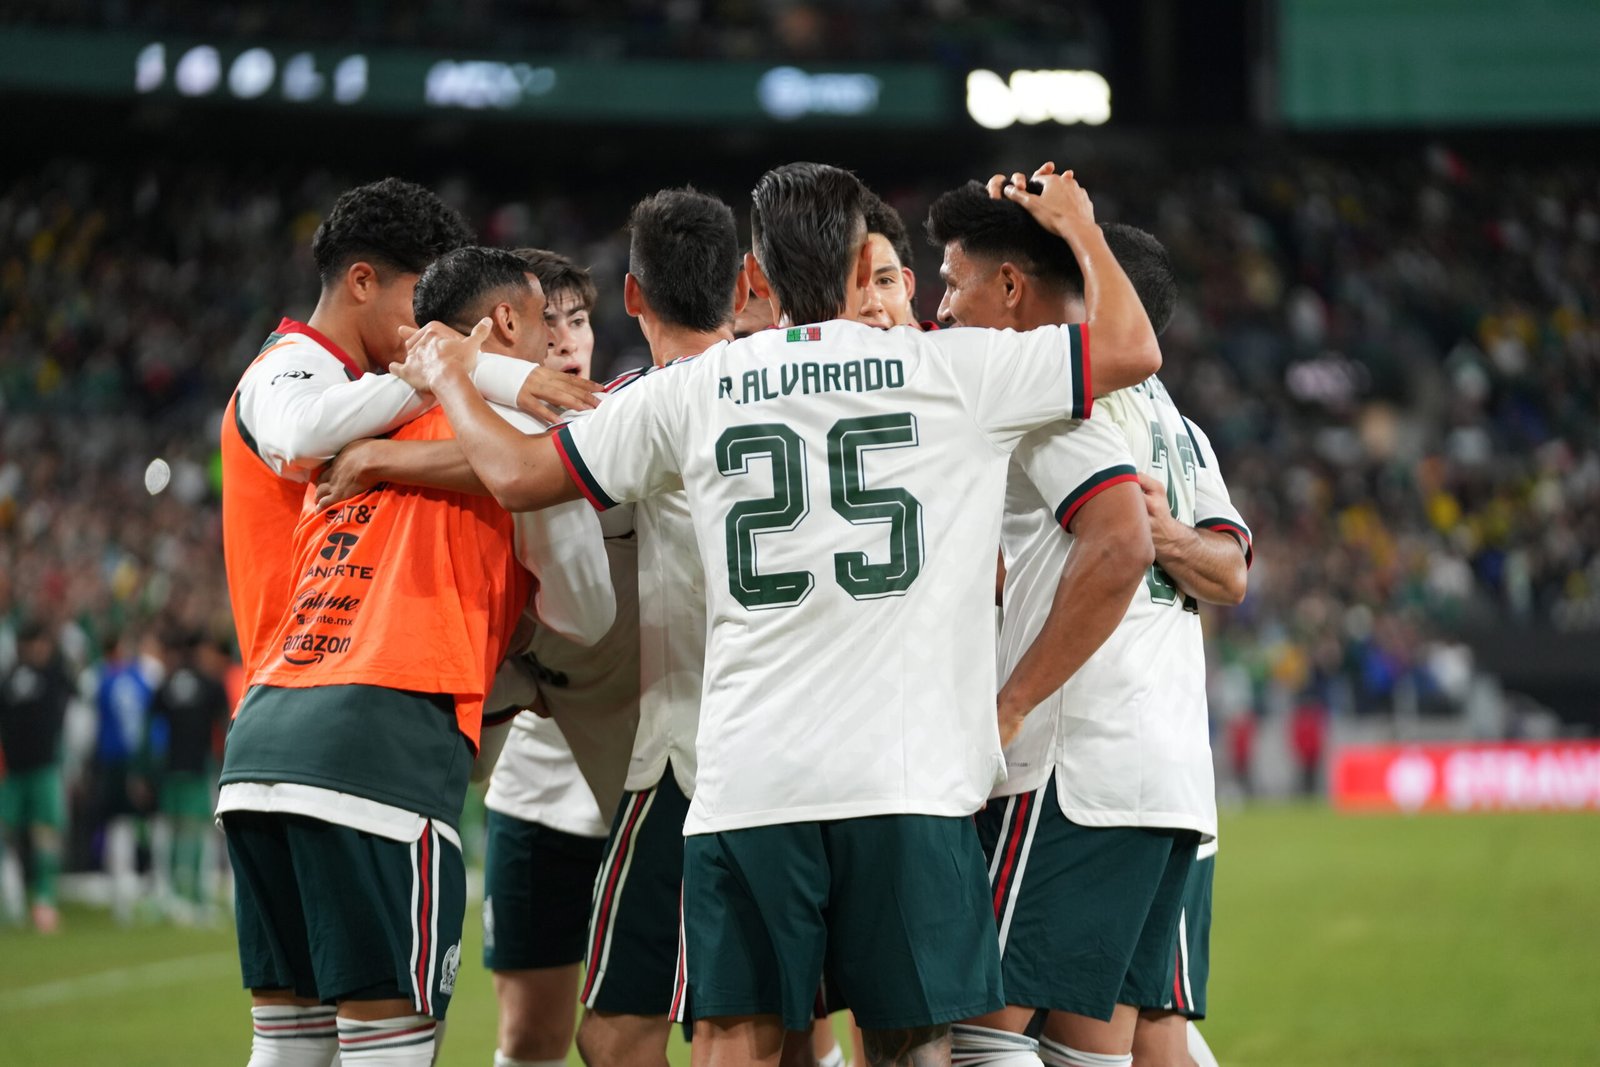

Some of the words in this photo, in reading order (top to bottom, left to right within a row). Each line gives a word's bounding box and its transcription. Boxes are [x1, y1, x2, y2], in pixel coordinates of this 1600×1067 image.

[718, 357, 905, 405] R.ALVARADO
[334, 504, 377, 524] AT&
[715, 411, 926, 611] 25
[305, 564, 374, 580] ANRTE
[293, 588, 361, 612] Calinte
[282, 633, 351, 654] amazon
